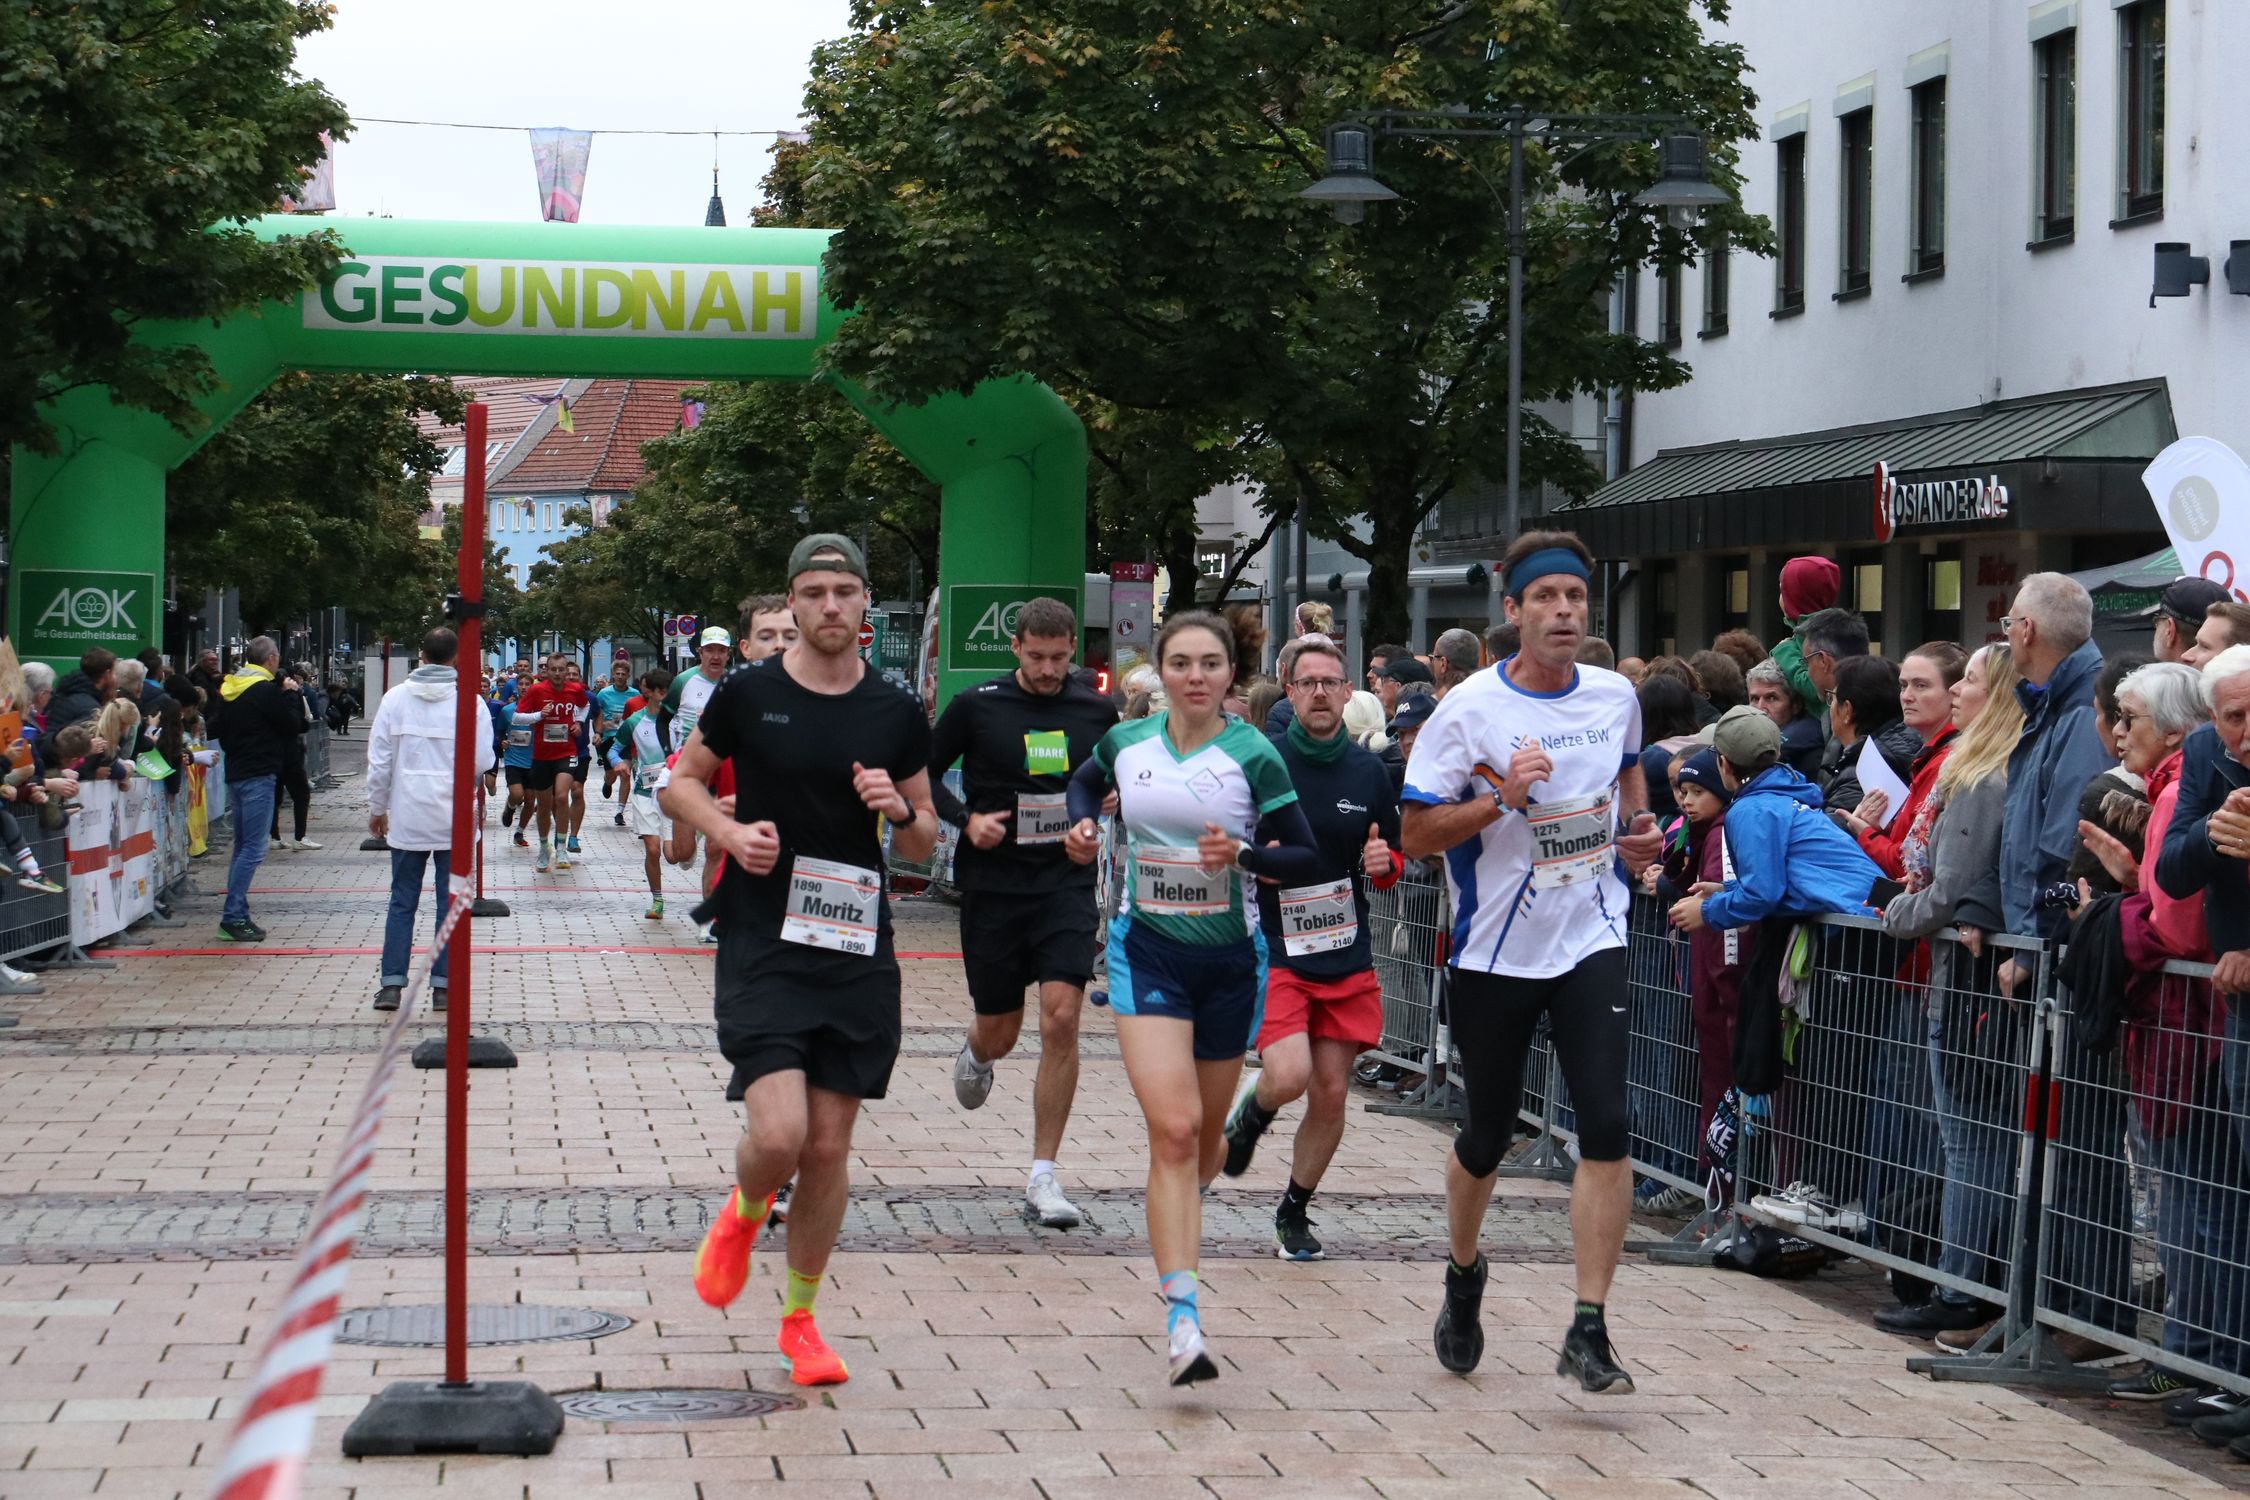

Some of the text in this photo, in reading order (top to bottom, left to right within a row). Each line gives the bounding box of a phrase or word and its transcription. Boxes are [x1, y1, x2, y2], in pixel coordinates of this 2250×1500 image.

[319, 261, 801, 334] GESUNDNAH
[1894, 475, 2007, 523] OSIANDER.de
[37, 587, 137, 629] AOK
[968, 601, 1027, 640] AO
[34, 628, 139, 641] Die Gesundheitskasse.
[965, 642, 979, 652] Die
[1541, 727, 1610, 751] Netze BW
[1029, 747, 1065, 759] LIBARE
[1020, 810, 1042, 818] 1902
[1035, 820, 1069, 834] Leon
[1532, 823, 1561, 838] 1275
[1539, 829, 1607, 859] Thomas
[1138, 865, 1164, 878] 1502
[1590, 862, 1606, 879] 1275
[793, 879, 822, 893] 1890
[1153, 880, 1208, 902] Helen
[801, 896, 864, 923] Moritz
[1282, 904, 1306, 916] 2140
[1293, 911, 1345, 932] Tobias
[840, 940, 866, 953] 1890
[1332, 936, 1352, 949] 2140
